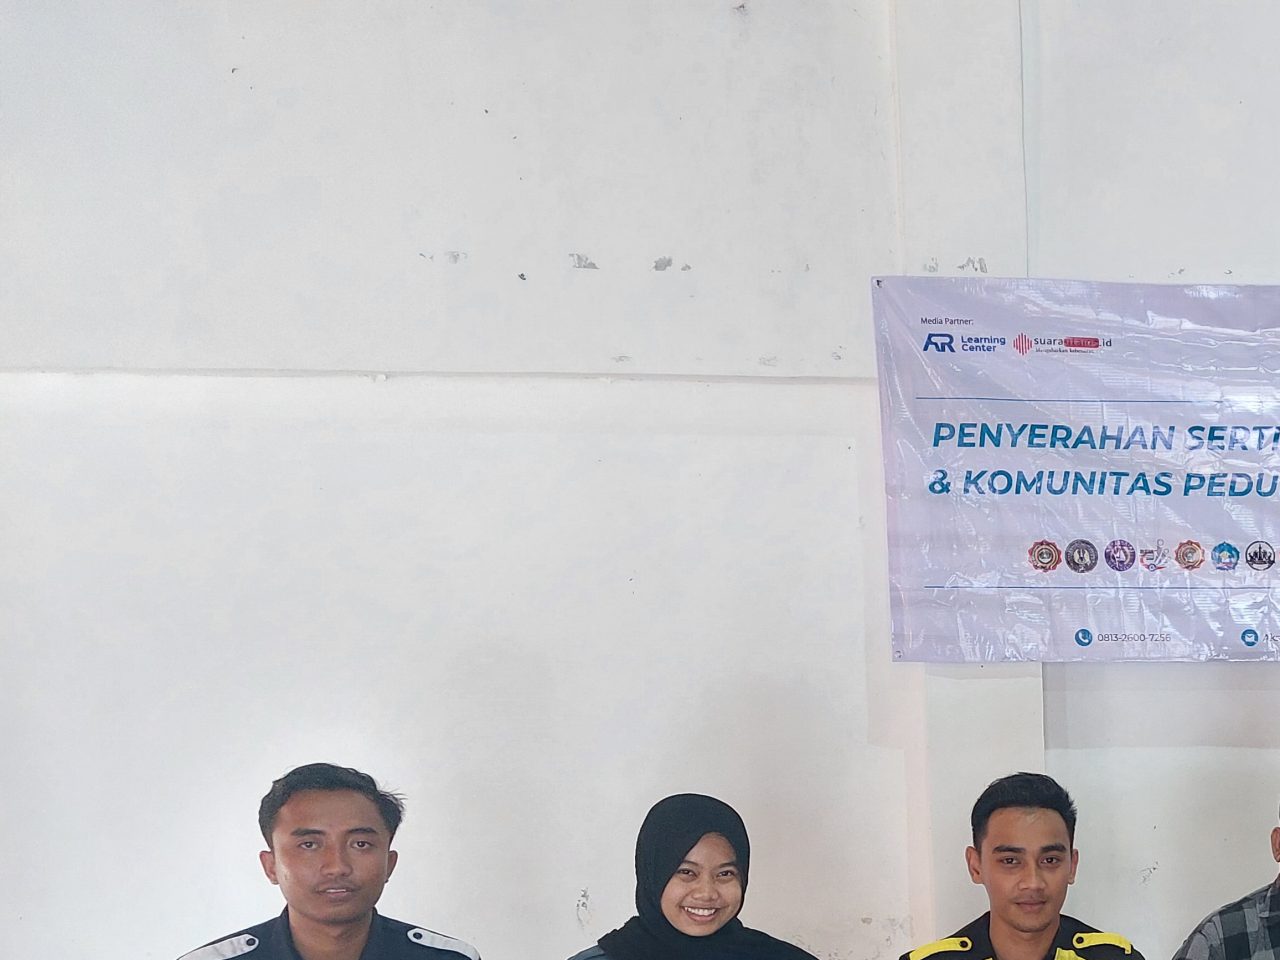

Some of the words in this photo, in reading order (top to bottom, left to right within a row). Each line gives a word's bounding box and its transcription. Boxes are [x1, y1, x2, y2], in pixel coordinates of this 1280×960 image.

[921, 317, 943, 325] Media
[945, 317, 974, 326] Partner:
[961, 336, 1006, 346] Learning
[961, 344, 997, 352] Center
[933, 422, 1175, 450] PENYERAHAN
[928, 469, 951, 494] &
[963, 470, 1173, 496] KOMUNITAS
[1097, 633, 1172, 642] 0813-2600-7256
